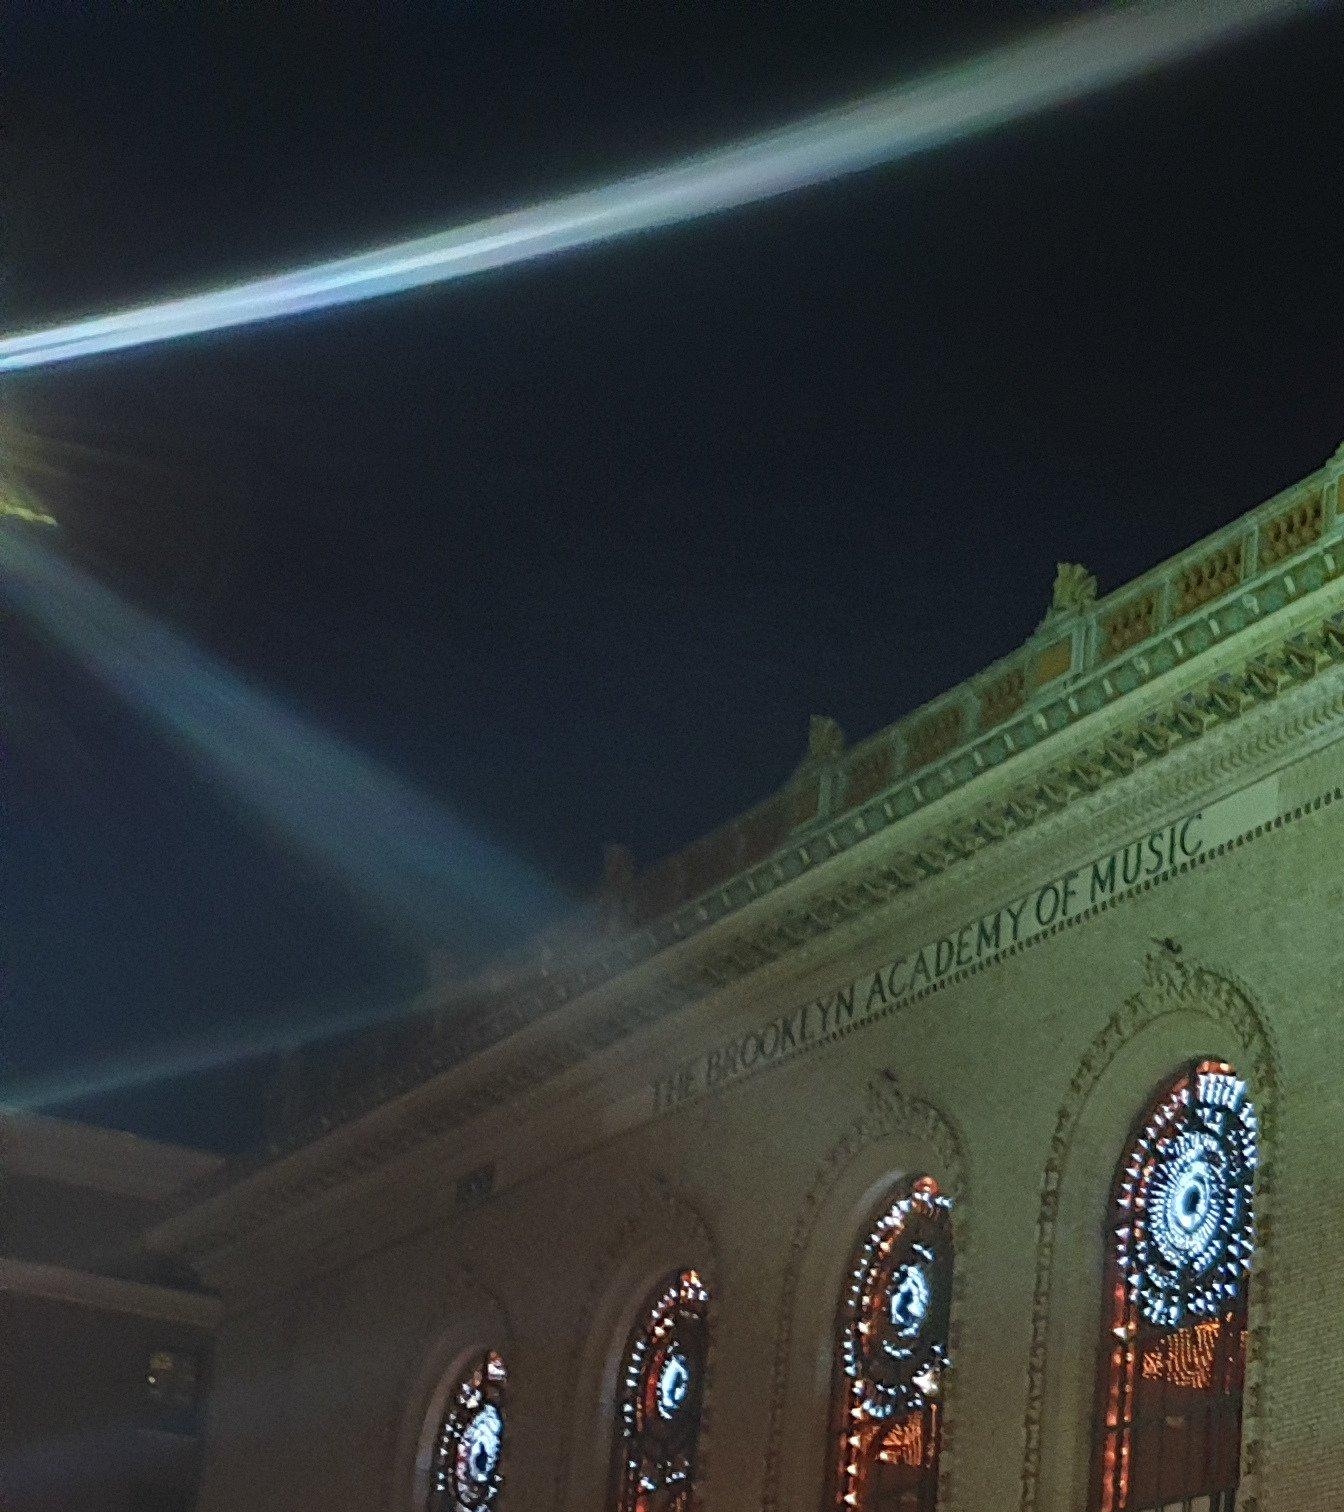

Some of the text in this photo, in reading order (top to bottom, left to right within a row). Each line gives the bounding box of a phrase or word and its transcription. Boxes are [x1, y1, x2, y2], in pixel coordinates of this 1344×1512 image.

[650, 813, 1204, 1110] THE BROOKLYN ACADEMY OF MUSIC
